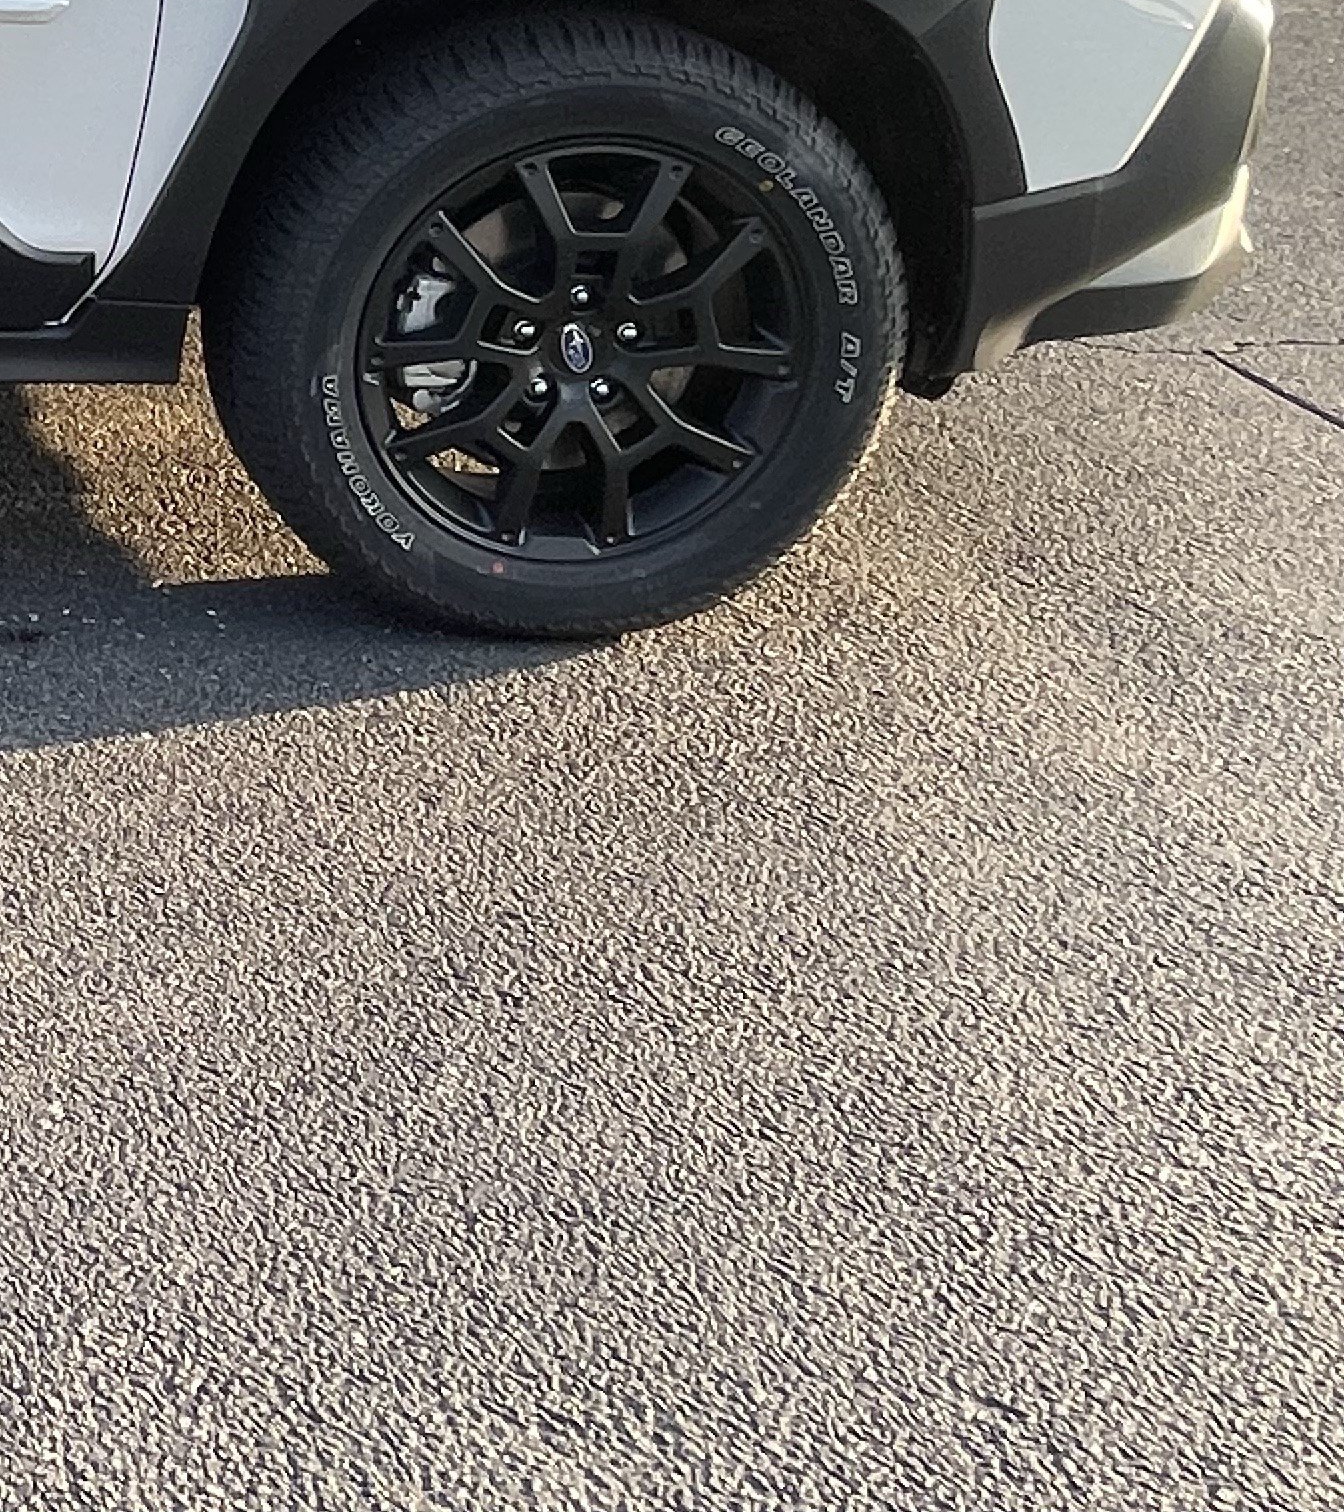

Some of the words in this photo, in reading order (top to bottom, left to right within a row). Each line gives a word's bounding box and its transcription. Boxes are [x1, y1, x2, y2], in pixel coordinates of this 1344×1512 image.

[715, 126, 858, 305] GEOLANDAR
[834, 331, 861, 404] A/T
[322, 374, 415, 551] YOKOHAMA
